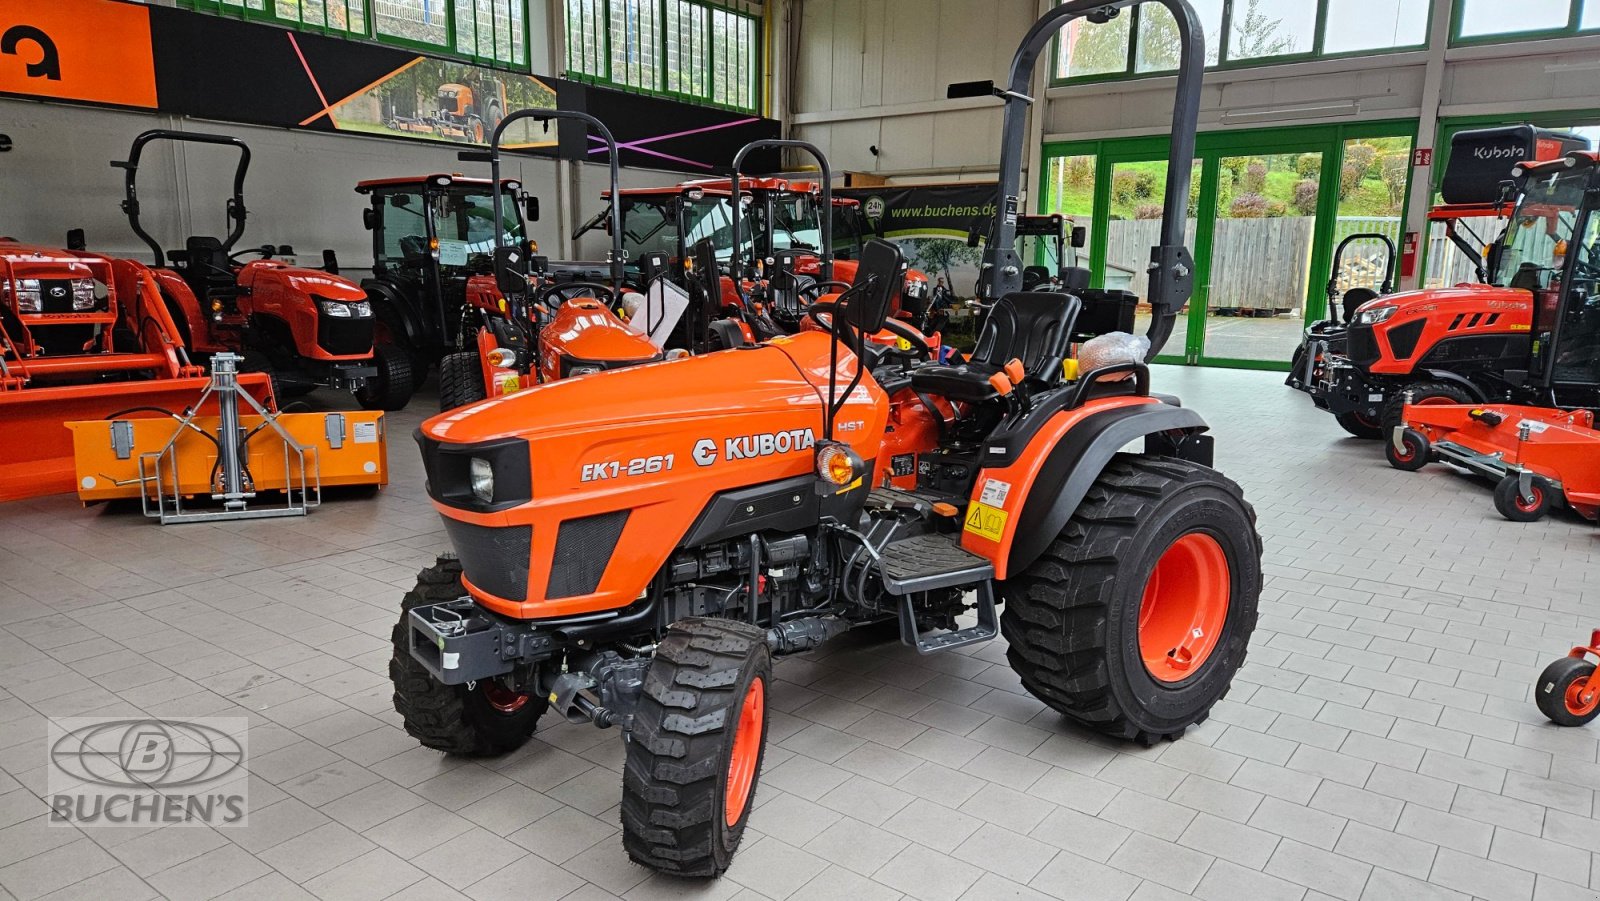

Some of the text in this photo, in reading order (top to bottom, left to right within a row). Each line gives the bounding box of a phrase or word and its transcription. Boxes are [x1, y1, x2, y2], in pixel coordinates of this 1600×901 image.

[1, 24, 61, 81] a
[1474, 145, 1525, 159] Kubota
[868, 201, 882, 210] 24h
[891, 203, 996, 218] www.buchens.de
[837, 420, 865, 432] HST
[725, 428, 815, 460] KUBOTA
[580, 453, 675, 482] EK1-261
